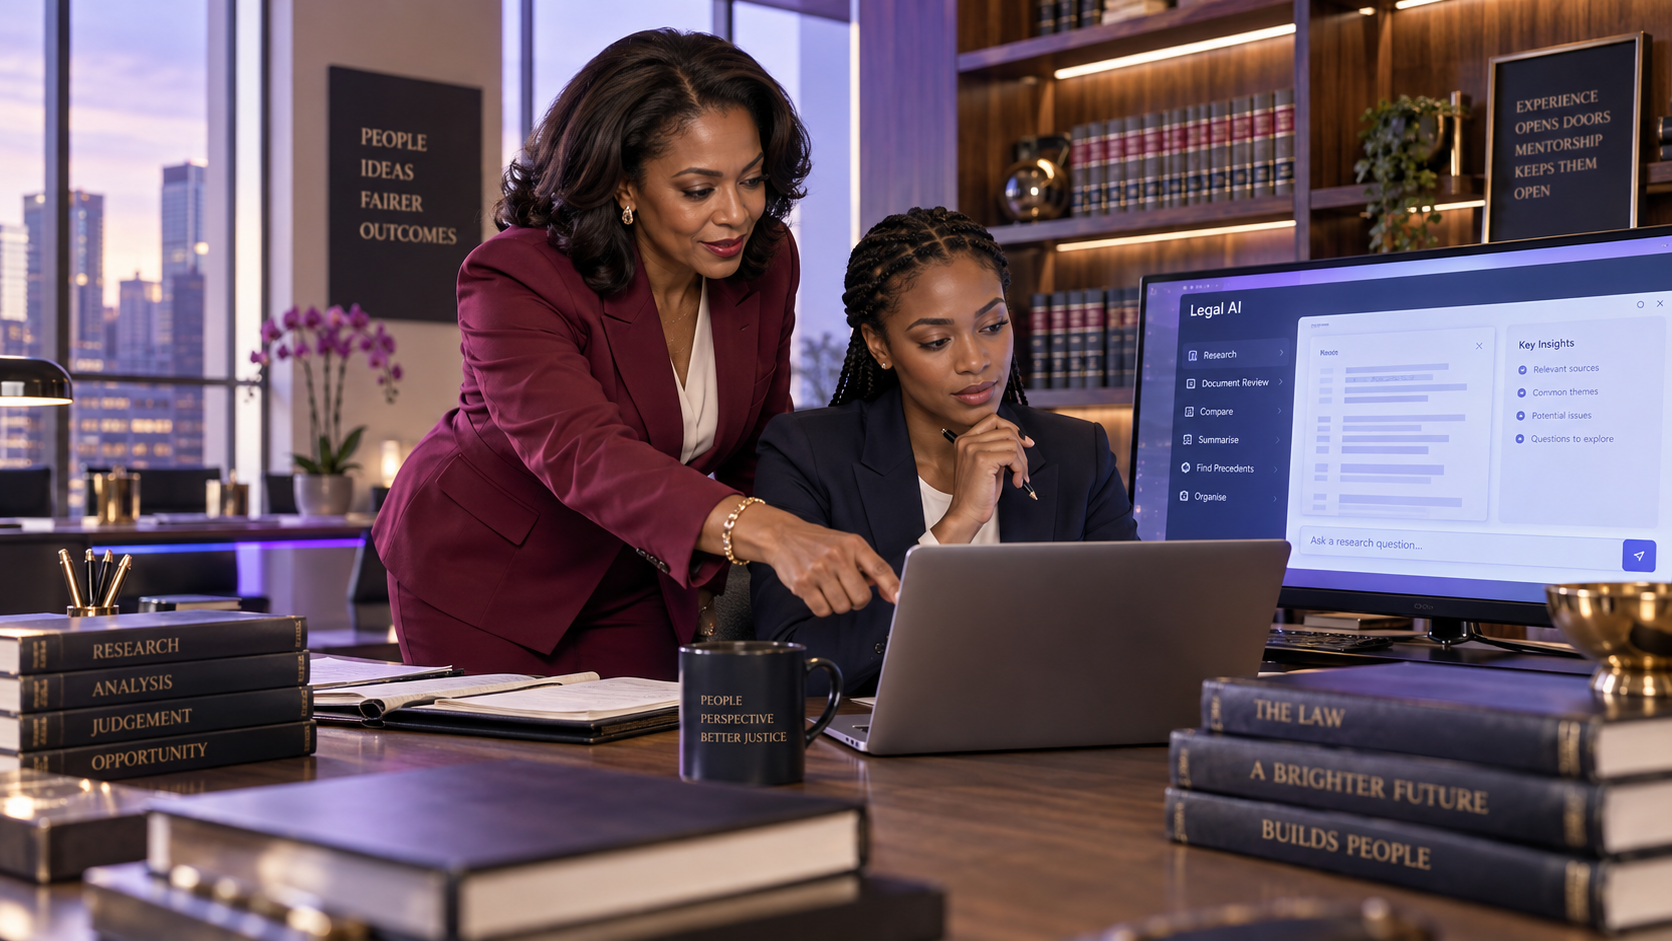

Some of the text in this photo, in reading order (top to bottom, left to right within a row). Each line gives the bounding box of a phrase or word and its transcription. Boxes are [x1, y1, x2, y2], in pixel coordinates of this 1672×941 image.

[1516, 90, 1599, 114] EXPERIENCE
[1515, 111, 1610, 135] OPENS DOORS
[362, 128, 426, 151] PEOPLE
[1515, 134, 1603, 157] MENTORSHIP
[362, 159, 413, 180] IDEAS
[1515, 157, 1596, 178] KEEPS THEM
[1514, 185, 1550, 199] OPEN
[361, 191, 422, 211] FAIRER
[360, 222, 456, 244] OUTCOMES
[1190, 300, 1242, 319] Legal AI
[1518, 338, 1575, 352] Key Insights
[1203, 349, 1237, 360] Research
[1533, 365, 1600, 374] Relevant sources
[1201, 377, 1270, 388] Document Review
[1532, 387, 1599, 397] Common themes
[1199, 406, 1234, 418] Compare
[1531, 411, 1592, 420] Potential issues
[1198, 435, 1240, 444] Summarise
[1530, 434, 1615, 445] Questions to explore
[1196, 463, 1255, 474] Find Precedents
[1194, 491, 1227, 503] Organise
[1310, 535, 1423, 550] Ask a research question...
[94, 638, 179, 659] RESEARCH
[93, 675, 172, 696] ANALYSIS
[701, 695, 742, 705] PEOPLE
[701, 714, 773, 724] PERSPECTIVE
[1253, 699, 1292, 723] THE
[1298, 703, 1347, 728] LAW
[91, 708, 193, 737] JUDGEMENT
[701, 732, 786, 744] BETTER JUSTICE
[91, 742, 208, 771] OPPORTUNITY
[1250, 760, 1490, 816] A BRIGHTER FUTURE
[1261, 819, 1432, 871] BUILDS PEOPLE
